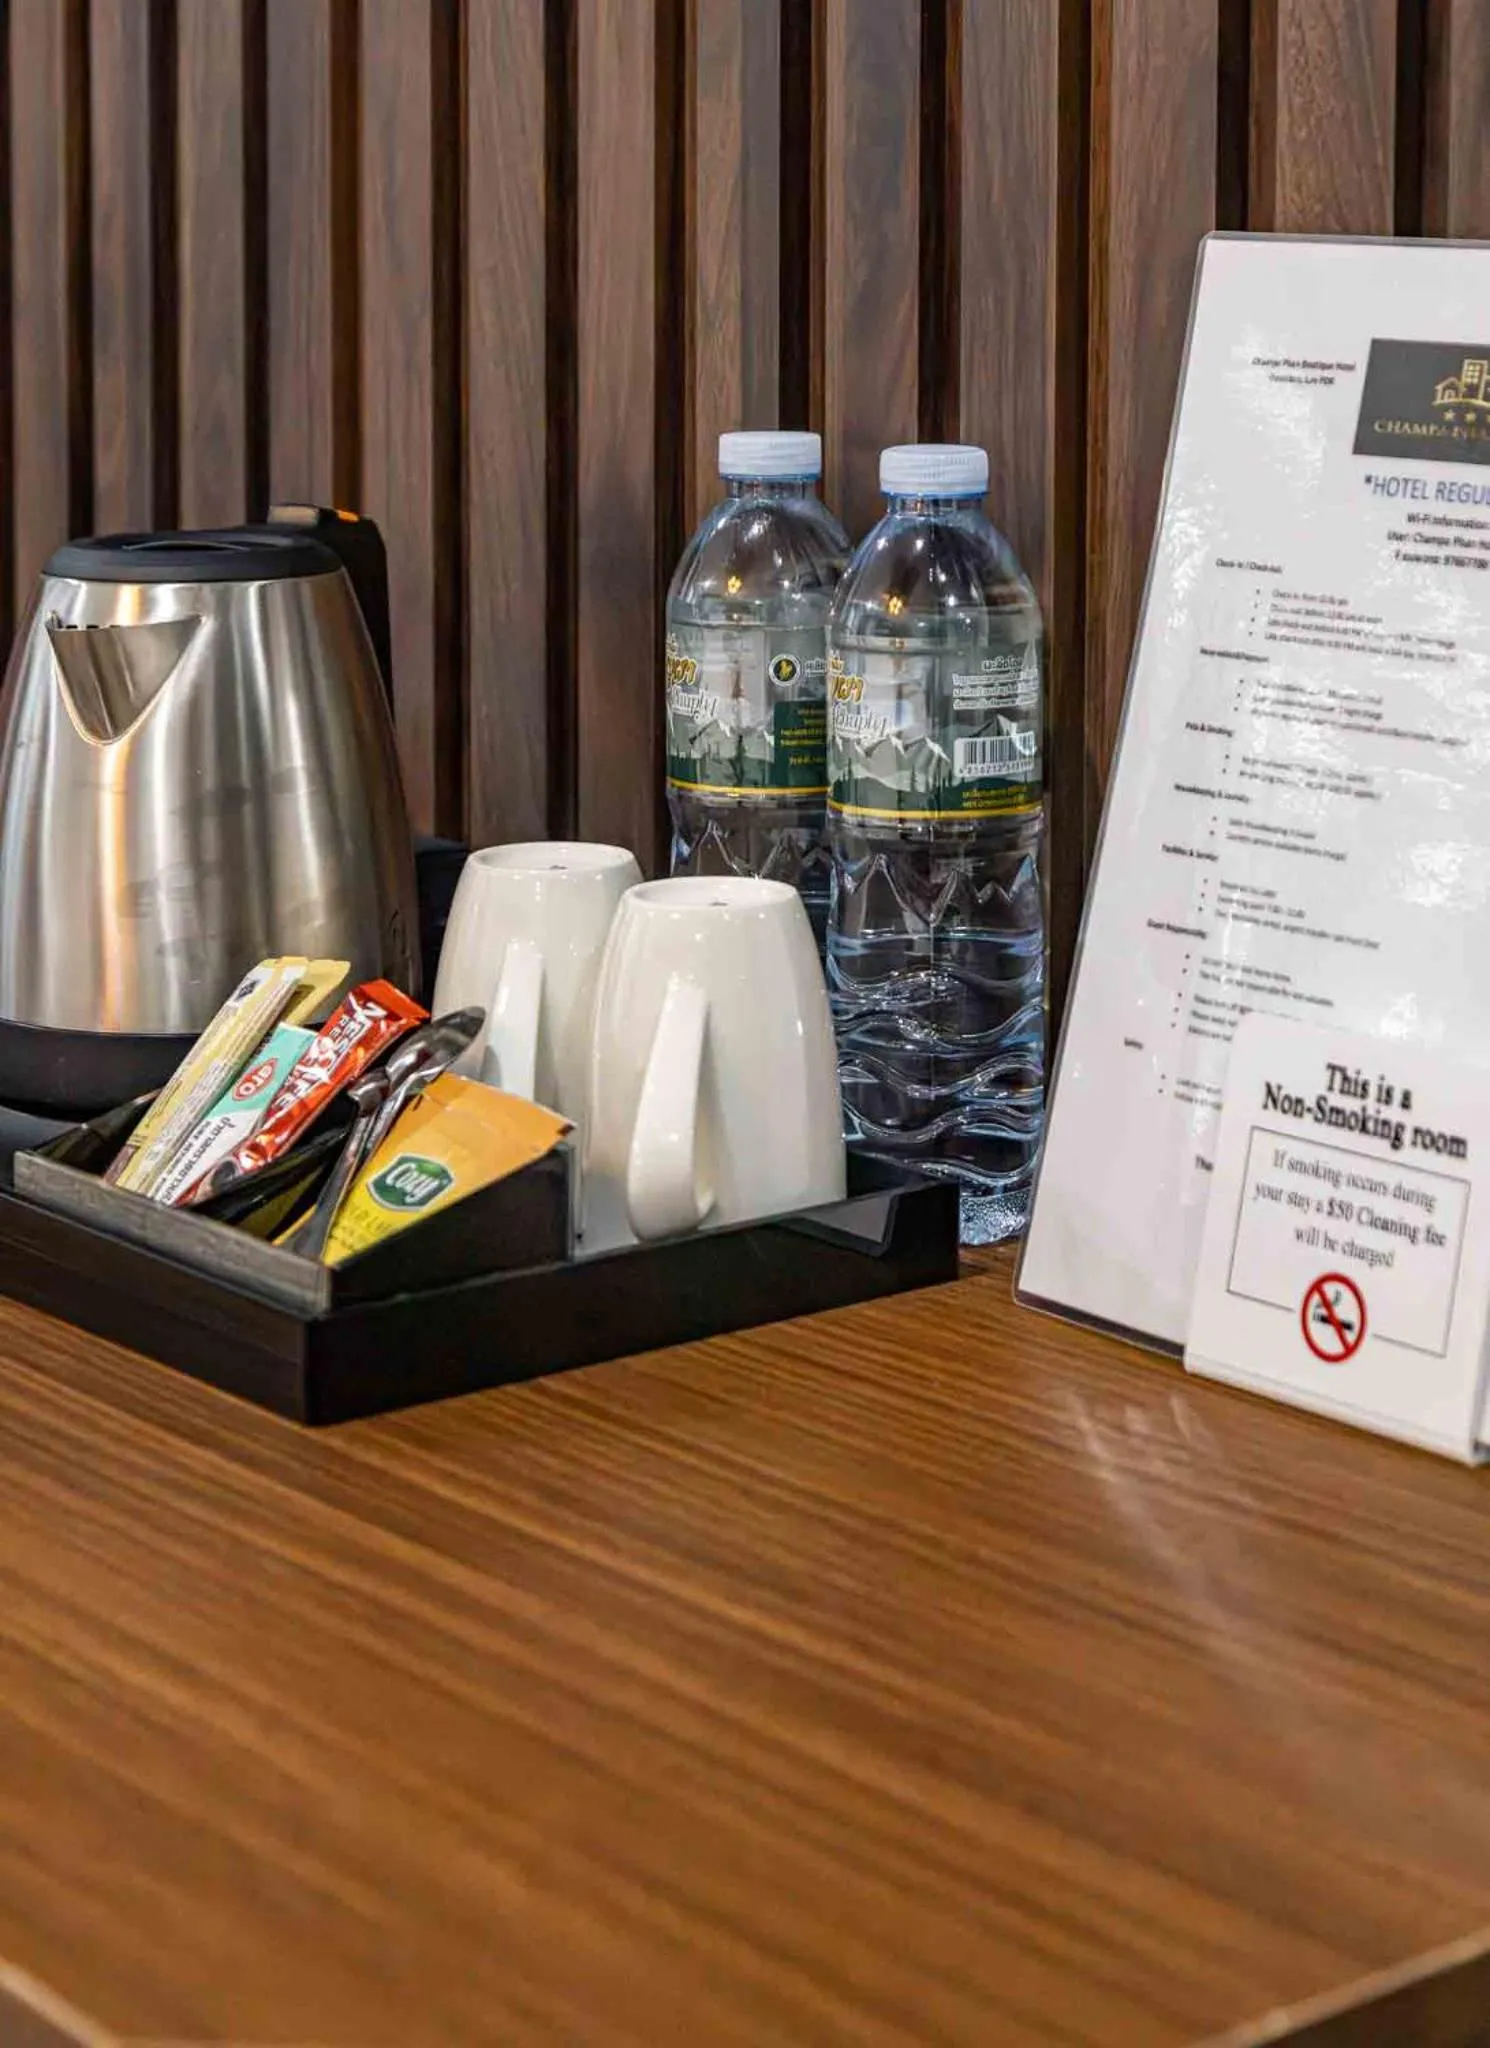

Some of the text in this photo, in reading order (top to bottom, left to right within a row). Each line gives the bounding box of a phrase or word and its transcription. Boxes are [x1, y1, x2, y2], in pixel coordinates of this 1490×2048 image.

[239, 1065, 274, 1097] aro
[1326, 1062, 1413, 1110] This is a
[1262, 1081, 1468, 1158] Non-Smoking room
[385, 1162, 441, 1204] Cozy
[1272, 1149, 1438, 1214] If smoking occurs during
[1253, 1181, 1447, 1248] your stay a $50 Cleaning fee
[1294, 1226, 1396, 1268] will be charged
